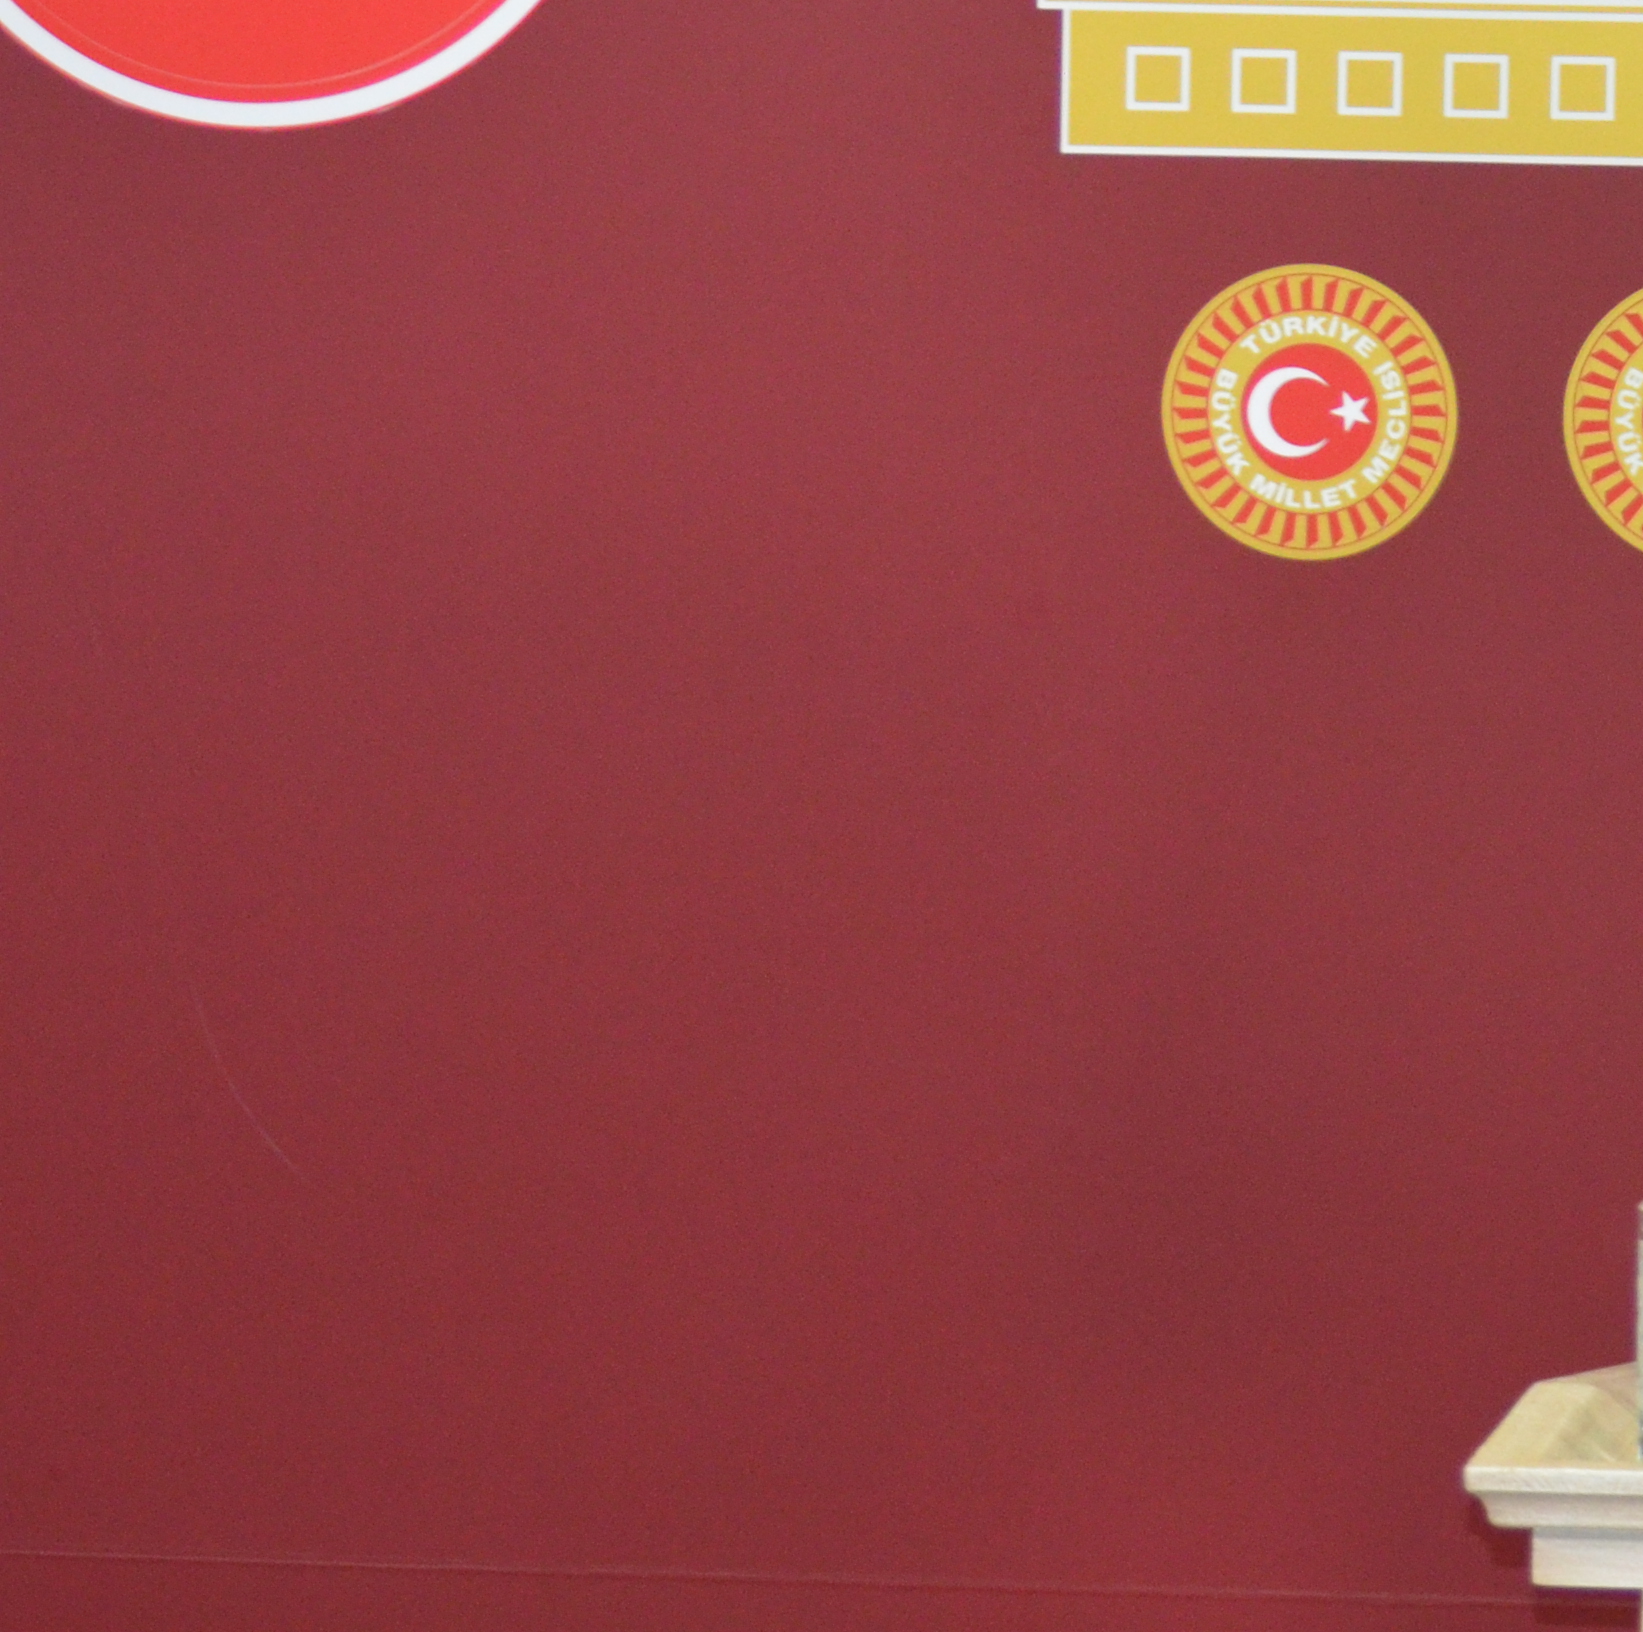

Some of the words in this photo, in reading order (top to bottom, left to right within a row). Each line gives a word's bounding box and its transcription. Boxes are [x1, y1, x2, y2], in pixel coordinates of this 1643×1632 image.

[1239, 314, 1378, 359] TÜRKİYE
[1211, 368, 1250, 477] BÜYÜK
[1249, 473, 1358, 509] MİLLET
